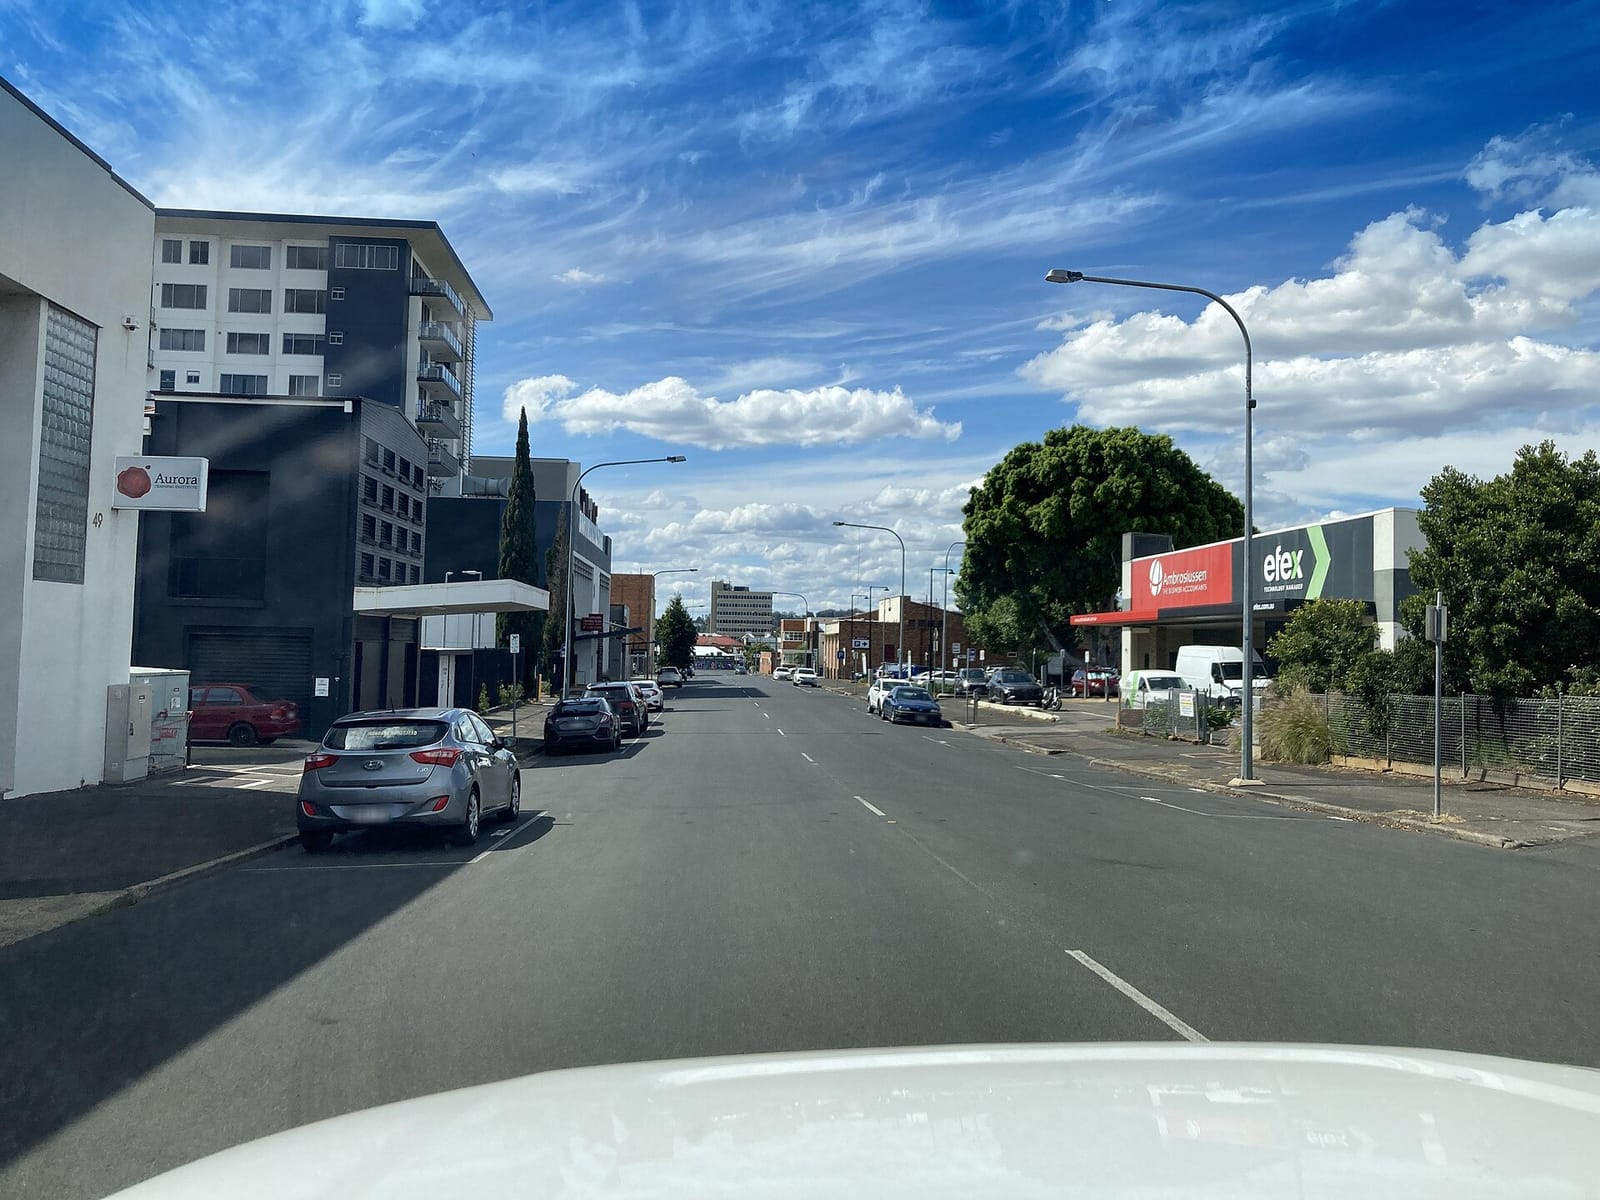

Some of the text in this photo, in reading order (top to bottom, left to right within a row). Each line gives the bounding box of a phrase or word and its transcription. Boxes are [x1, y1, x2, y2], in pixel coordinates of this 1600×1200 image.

[154, 473, 198, 485] Aurora
[92, 512, 103, 528] 49
[1263, 545, 1304, 582] efex
[1162, 570, 1207, 585] Ambrosiussen
